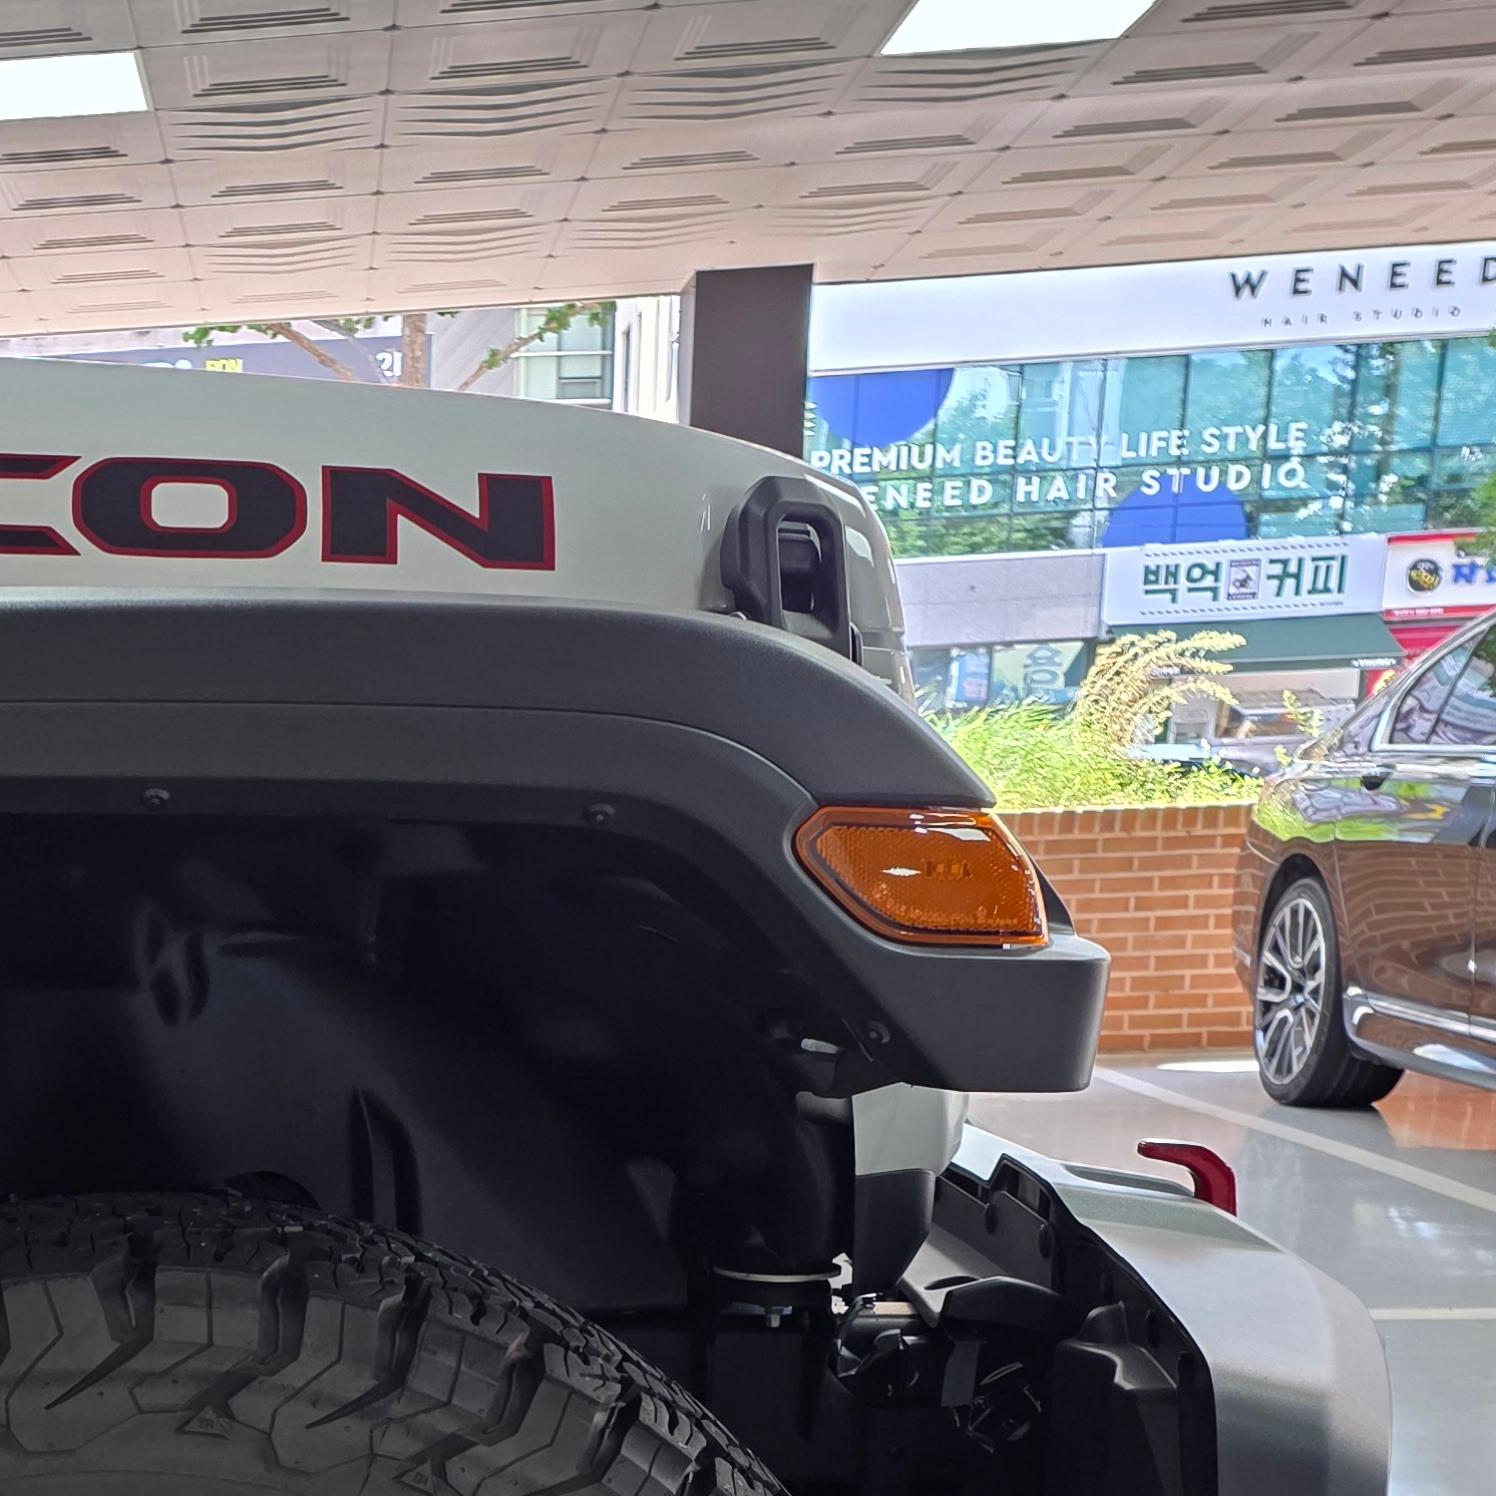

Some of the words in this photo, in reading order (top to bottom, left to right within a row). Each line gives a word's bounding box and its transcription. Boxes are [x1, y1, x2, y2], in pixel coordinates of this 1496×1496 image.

[1229, 256, 1496, 300] WENEED
[1261, 312, 1329, 328] HAIR
[1353, 304, 1461, 322] STUDIO
[810, 442, 961, 474] PREMIUM
[1120, 429, 1191, 459] LIFE
[1200, 421, 1308, 455] STYLE
[1016, 472, 1118, 504] HAIR
[1140, 462, 1307, 496] STUDIO
[1143, 561, 1223, 605] 백억
[1266, 554, 1349, 598] 커피
